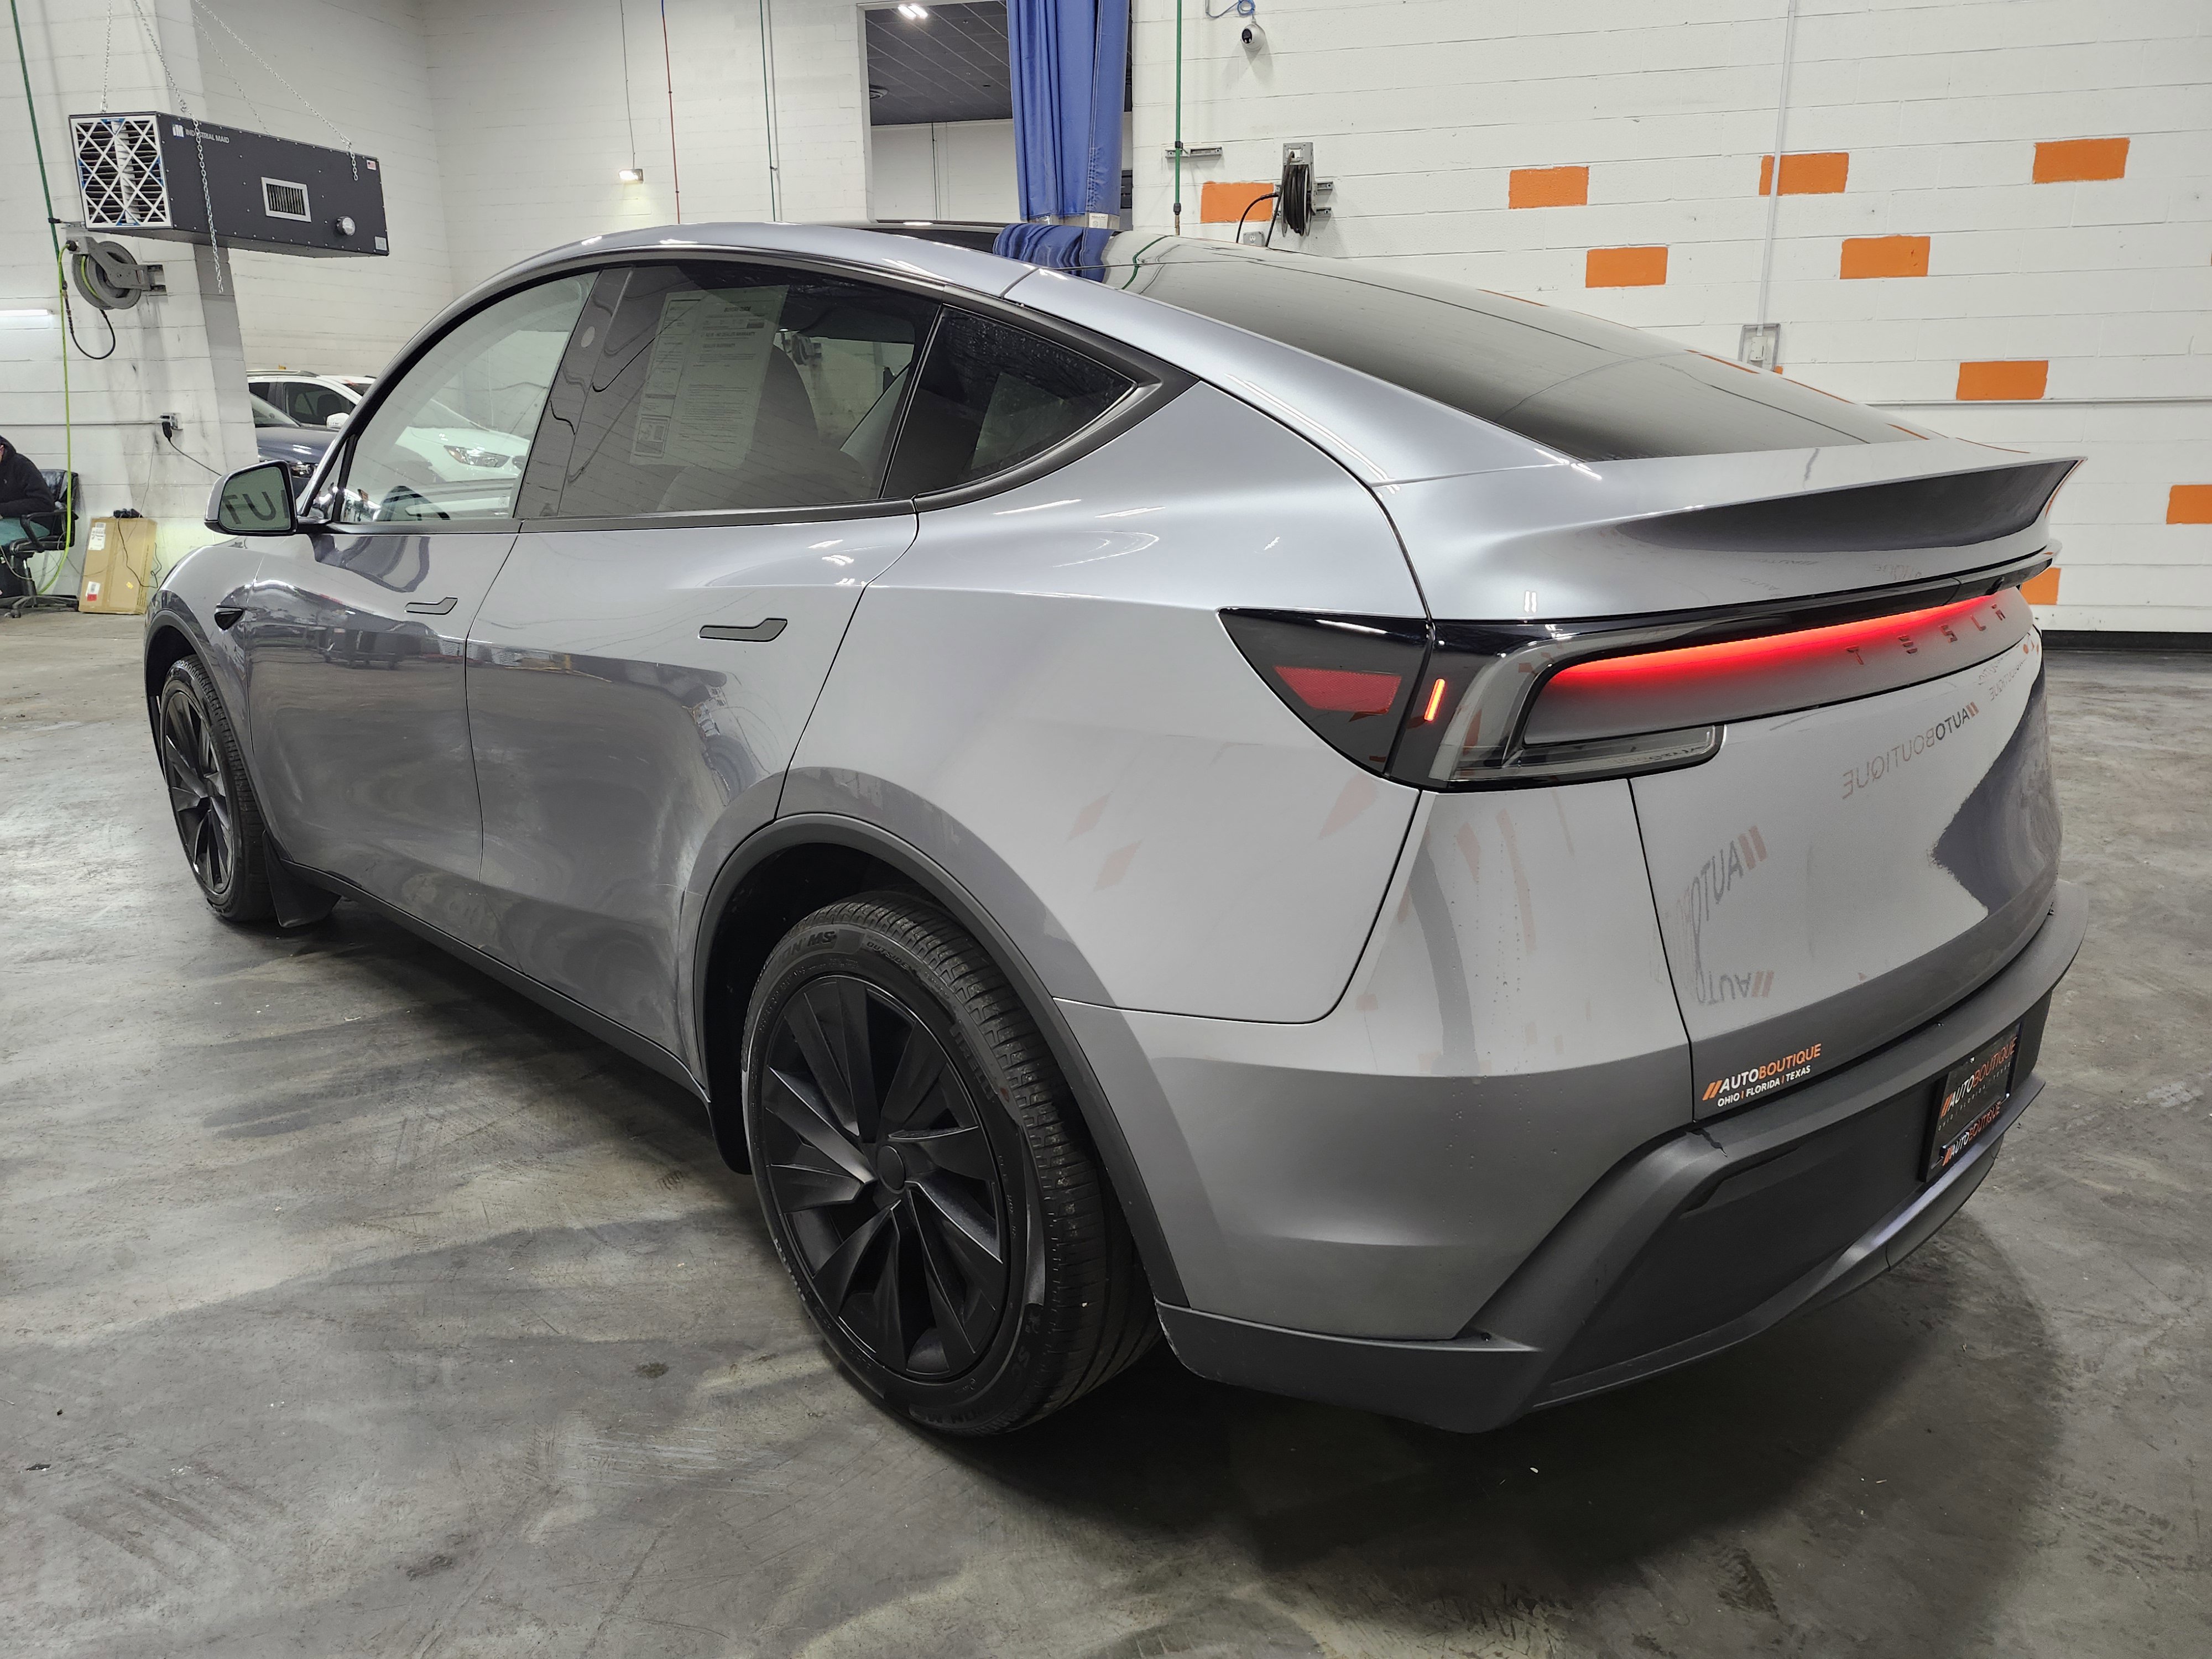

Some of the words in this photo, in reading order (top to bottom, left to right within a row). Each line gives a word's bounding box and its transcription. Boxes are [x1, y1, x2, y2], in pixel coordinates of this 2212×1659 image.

[215, 135, 229, 143] MAID
[1845, 603, 2006, 665] TESLA
[867, 941, 910, 969] OUTSIDE
[1718, 1093, 1740, 1107] OHIO
[1745, 1077, 1780, 1098] FLORIDA
[1786, 1065, 1811, 1082] TEXAS
[1719, 1043, 1822, 1094] AUTOBOUTIQUE
